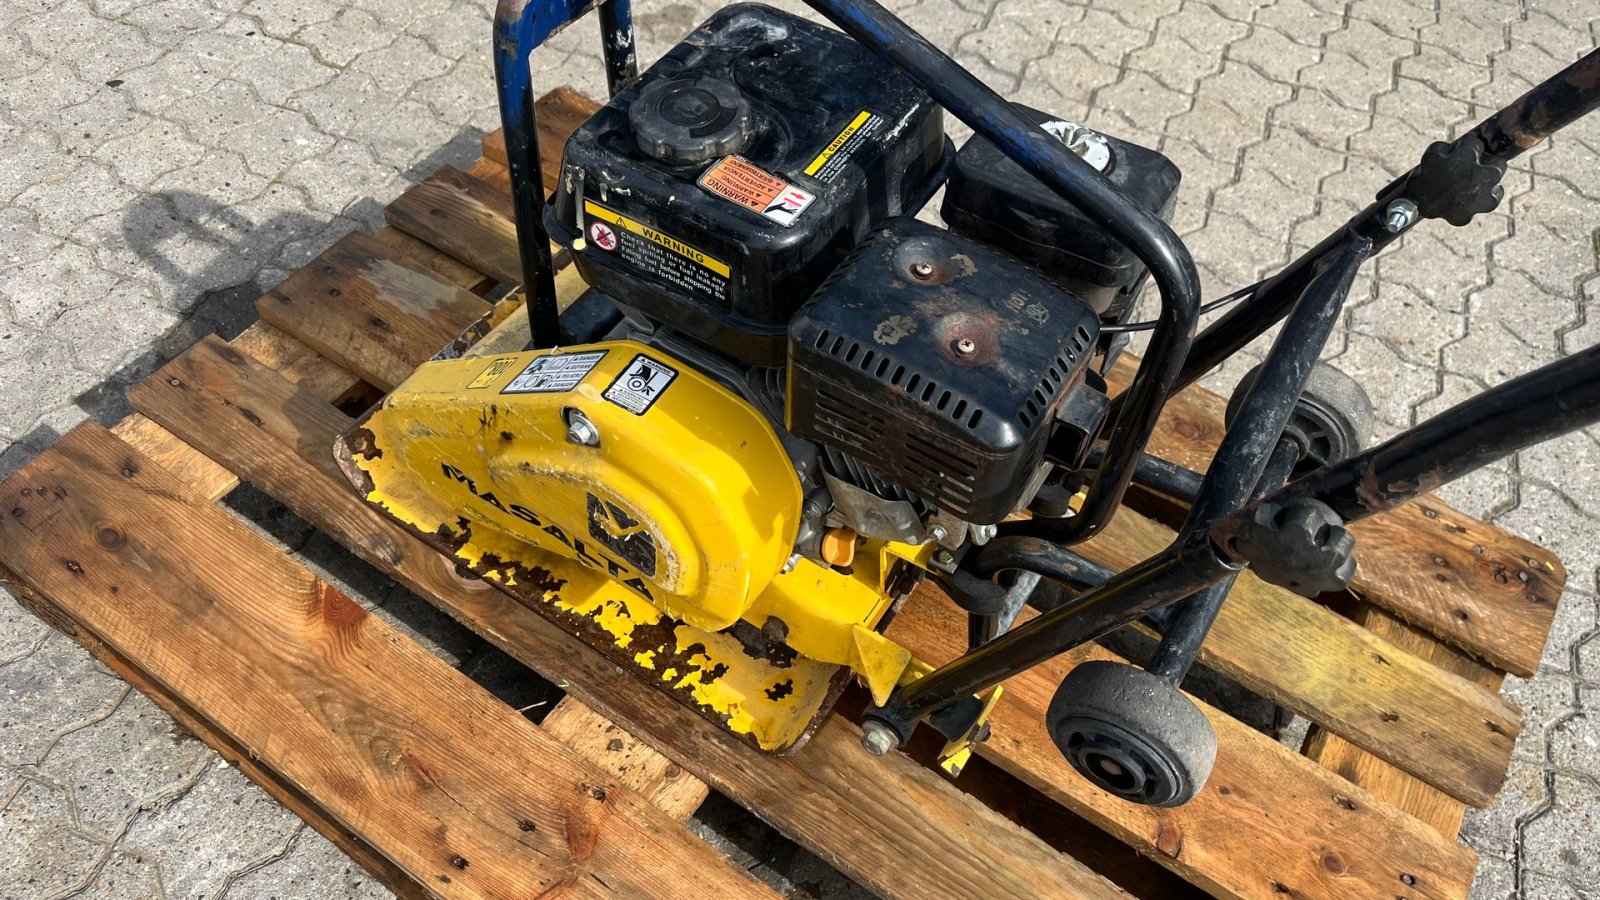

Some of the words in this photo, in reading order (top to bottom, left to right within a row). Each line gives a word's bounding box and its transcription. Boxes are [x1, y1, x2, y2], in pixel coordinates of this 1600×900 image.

[828, 127, 855, 152] CAUTION
[707, 179, 749, 204] WARNING
[721, 175, 754, 195] WARNUNG
[724, 166, 766, 189] ADVERTENCIA
[621, 232, 644, 245] Check
[648, 243, 663, 255] that
[667, 252, 686, 266] there
[689, 263, 696, 271] is
[700, 269, 709, 277] no
[712, 276, 726, 287] any
[643, 227, 704, 263] WARNING
[621, 239, 635, 249] fuel
[638, 245, 665, 263] spilling
[669, 260, 676, 268] or
[679, 265, 693, 276] fuel
[696, 272, 726, 293] leakage.
[621, 253, 645, 267] engine
[658, 269, 695, 292] forbidden.
[621, 246, 641, 261] Filling
[645, 256, 656, 266] fuel
[660, 263, 681, 277] before
[684, 276, 711, 294] stopping
[715, 291, 726, 300] the
[647, 360, 670, 374] WARNING
[440, 462, 655, 603] MASALTA
